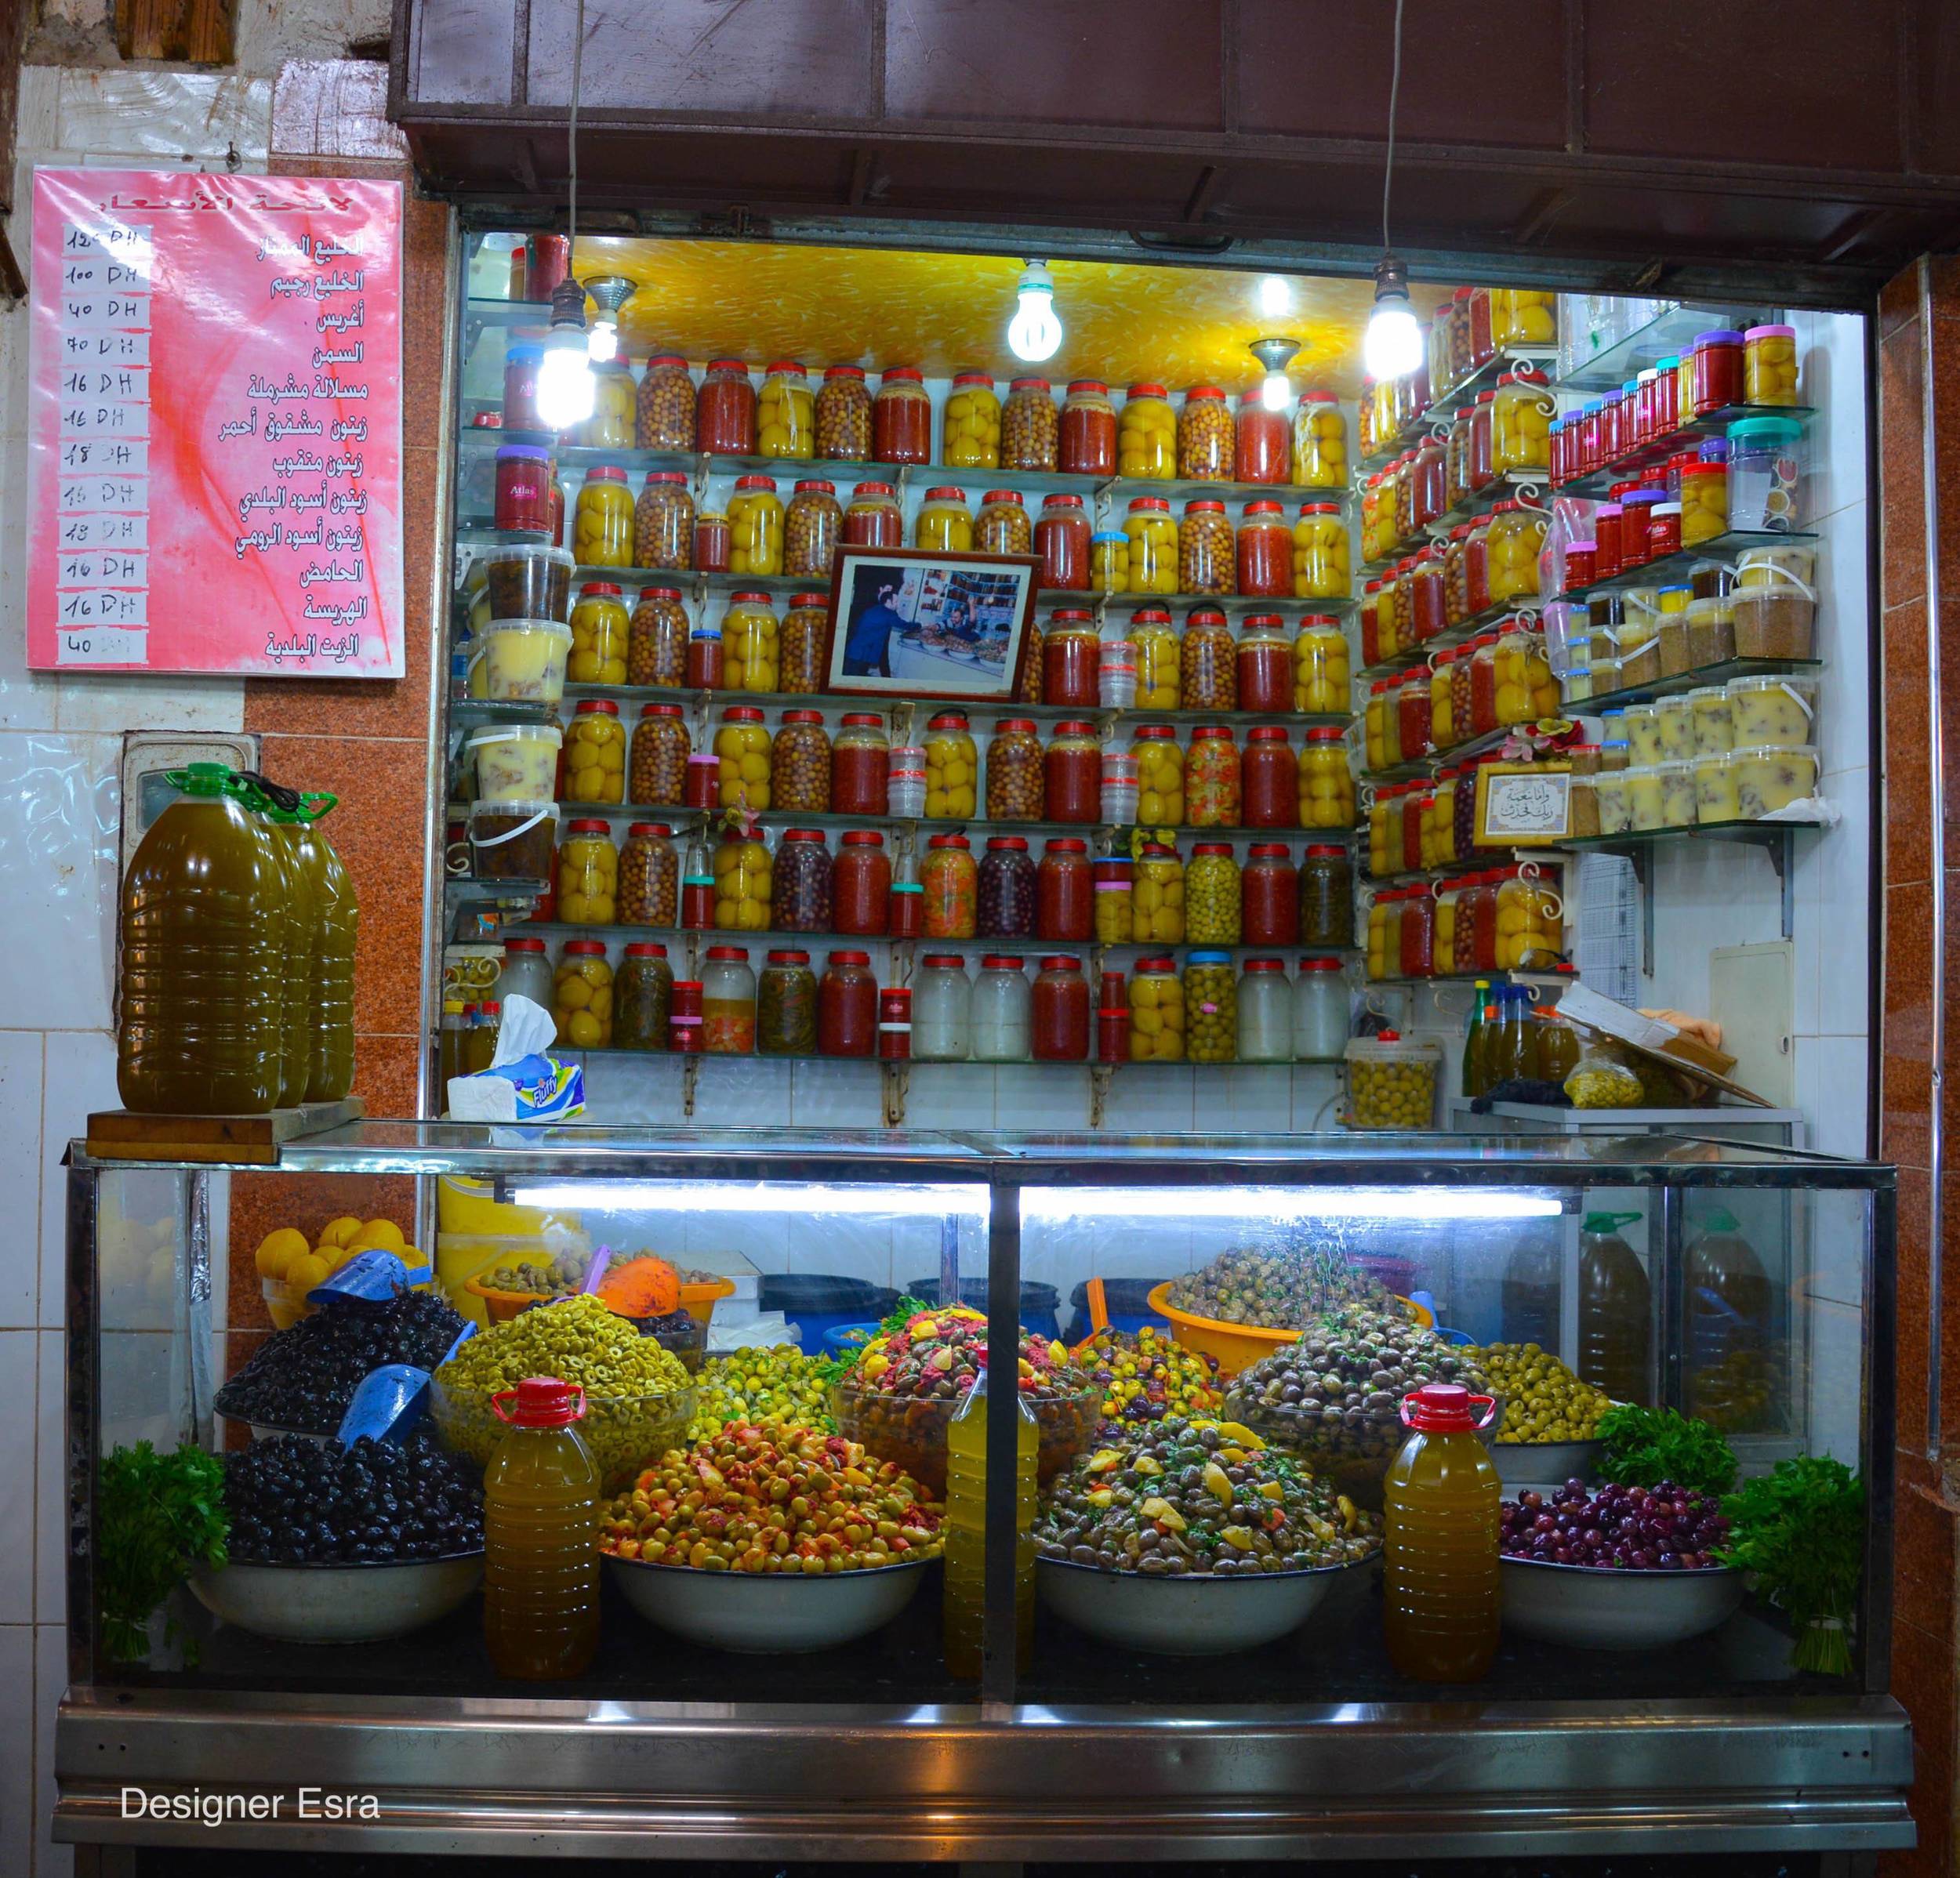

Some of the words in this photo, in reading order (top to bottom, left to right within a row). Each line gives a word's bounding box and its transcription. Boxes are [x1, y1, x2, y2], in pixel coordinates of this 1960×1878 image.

[65, 266, 93, 284] 100
[107, 266, 137, 285] DH
[270, 277, 310, 299] رجيم
[314, 270, 364, 301] الخليع
[68, 303, 93, 318] 40
[108, 300, 137, 317] DH
[316, 301, 365, 333] أغريس
[67, 337, 89, 353] 70
[99, 337, 132, 354] DH
[312, 341, 364, 369] السمن
[64, 372, 86, 393] 16
[100, 373, 132, 394] DH
[247, 373, 309, 405] مشرملة
[312, 374, 368, 400] مسلالة
[97, 408, 124, 426] DH
[218, 406, 257, 441] أحمر
[264, 409, 323, 441] مشقوق
[330, 415, 368, 442] زيتون
[64, 444, 92, 466] 18
[325, 451, 364, 478] زيتون
[102, 483, 134, 503] DH
[239, 485, 287, 523] البلدي
[289, 479, 328, 515] أسود
[330, 488, 368, 515] زيتون
[510, 485, 535, 497] Atlas
[235, 522, 282, 560] الرومي
[285, 516, 323, 552] أسود
[325, 526, 364, 552] زيتون
[103, 557, 135, 578] DH
[299, 559, 364, 588] الحامض
[65, 596, 91, 618] 16
[101, 594, 136, 619] DH
[303, 594, 368, 626] الهريسة
[68, 636, 91, 653] 40
[264, 632, 317, 664] البلدية
[320, 633, 359, 664] الزيت
[533, 1075, 557, 1108] Fluffy
